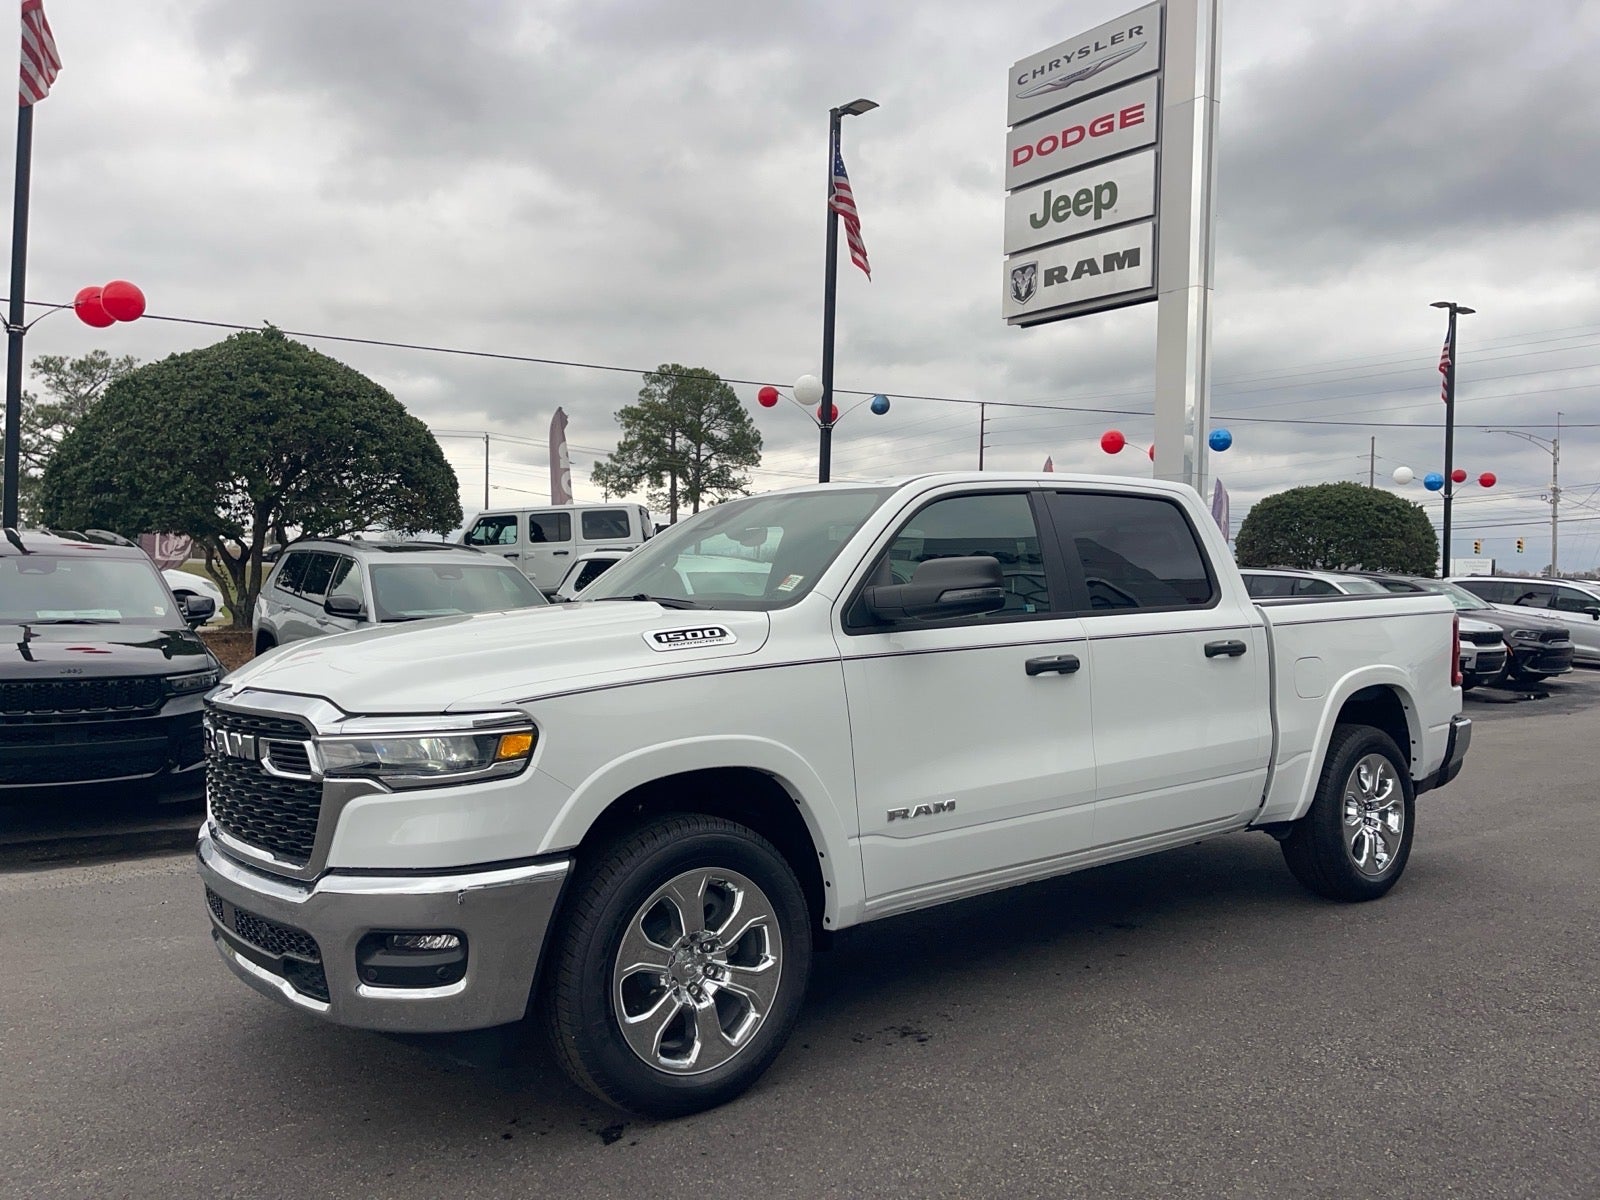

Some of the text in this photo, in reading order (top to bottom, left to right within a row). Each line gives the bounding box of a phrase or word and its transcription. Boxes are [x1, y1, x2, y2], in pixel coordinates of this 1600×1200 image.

[1017, 25, 1144, 85] CHRYSLER
[1012, 103, 1145, 168] DODGE
[1029, 180, 1118, 230] Jeep
[1043, 247, 1141, 288] RAM
[659, 627, 721, 643] 1500
[204, 726, 257, 761] RAM
[886, 798, 956, 823] RAM
